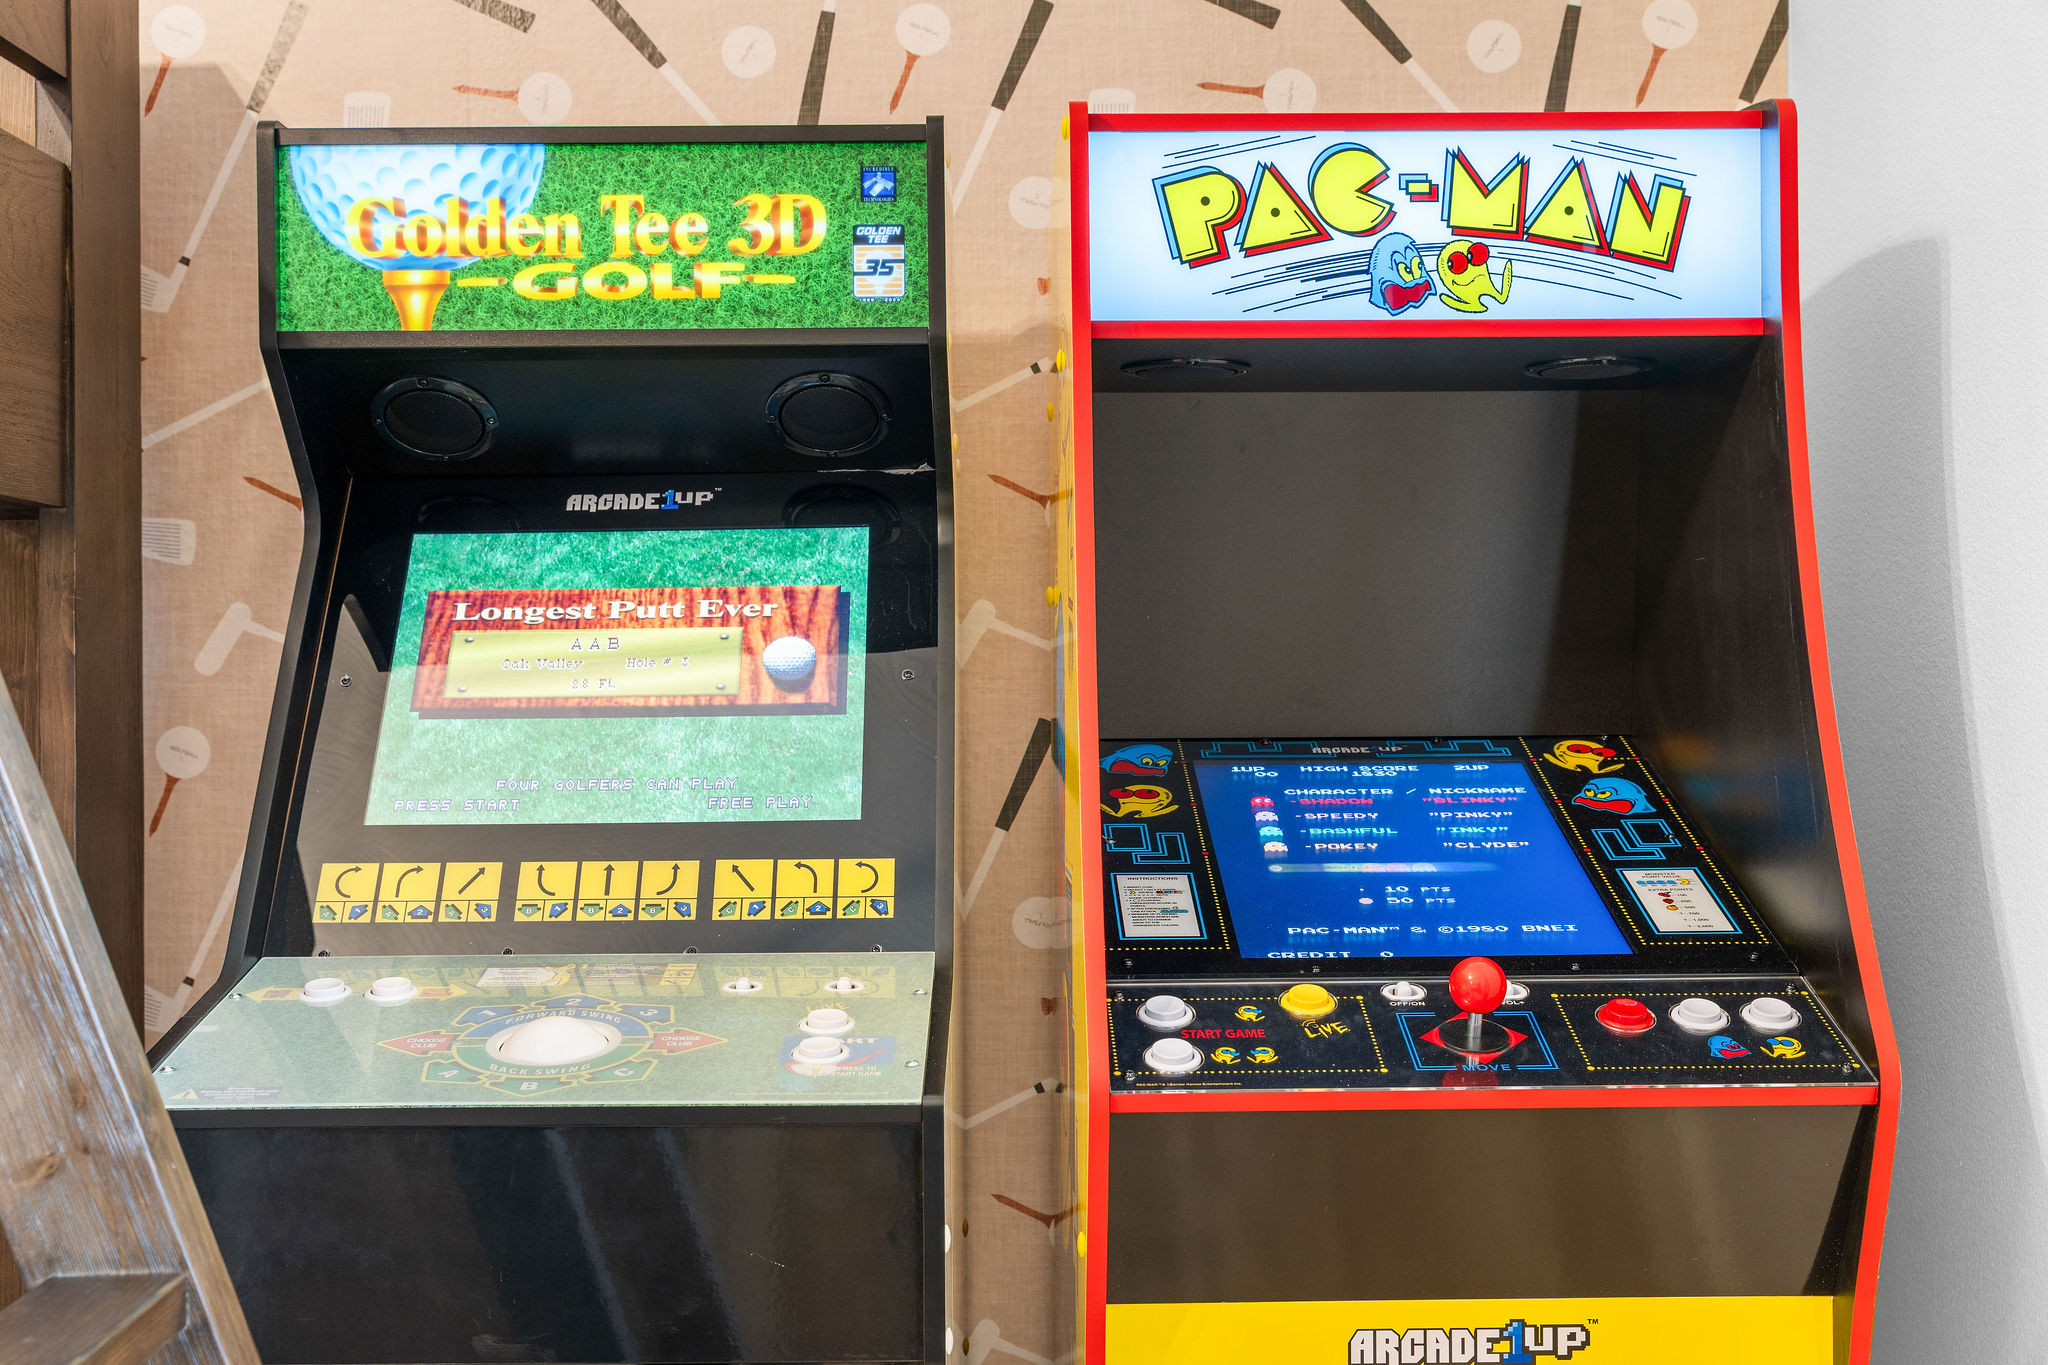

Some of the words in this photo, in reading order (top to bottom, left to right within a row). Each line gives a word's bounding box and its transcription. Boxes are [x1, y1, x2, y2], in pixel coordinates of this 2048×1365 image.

[1152, 141, 1692, 272] PAC-MAN
[345, 194, 581, 260] Golden
[597, 193, 710, 259] Tee
[727, 193, 827, 258] 3D
[856, 226, 902, 236] GOLDEN
[868, 235, 889, 244] TEE
[865, 258, 895, 277] 35
[452, 601, 597, 625] Longest
[608, 600, 686, 619] Putt
[697, 599, 778, 619] Ever
[501, 659, 530, 670] Oak
[536, 658, 584, 671] Valley
[625, 657, 657, 669] Hole
[1359, 764, 1419, 772] SCORE
[495, 778, 542, 791] FOUR
[553, 778, 634, 791] GOLFERS
[646, 777, 679, 790] CAN
[690, 777, 738, 790] PLAY
[393, 799, 451, 812] PRESS
[463, 799, 520, 812] START
[707, 796, 754, 809] FREE
[766, 795, 813, 809] PLAY
[1385, 885, 1409, 893] 10
[1420, 885, 1451, 893] PTS
[417, 908, 423, 916] 2
[815, 904, 822, 912] 2
[1522, 924, 1578, 933] BNEI
[1267, 951, 1351, 959] CREDIT
[564, 998, 581, 1007] 2
[505, 1009, 578, 1025] FORWARD
[581, 1009, 623, 1024] SWING
[1181, 1029, 1222, 1039] START
[1225, 1028, 1266, 1039] GAME
[1304, 1022, 1350, 1039] LIVE
[661, 1035, 702, 1043] CHOOSE
[489, 1063, 531, 1076] BACK
[534, 1063, 592, 1075] SWING
[1461, 1064, 1512, 1072] MOVE
[439, 1069, 459, 1078] A
[519, 1081, 540, 1091] B
